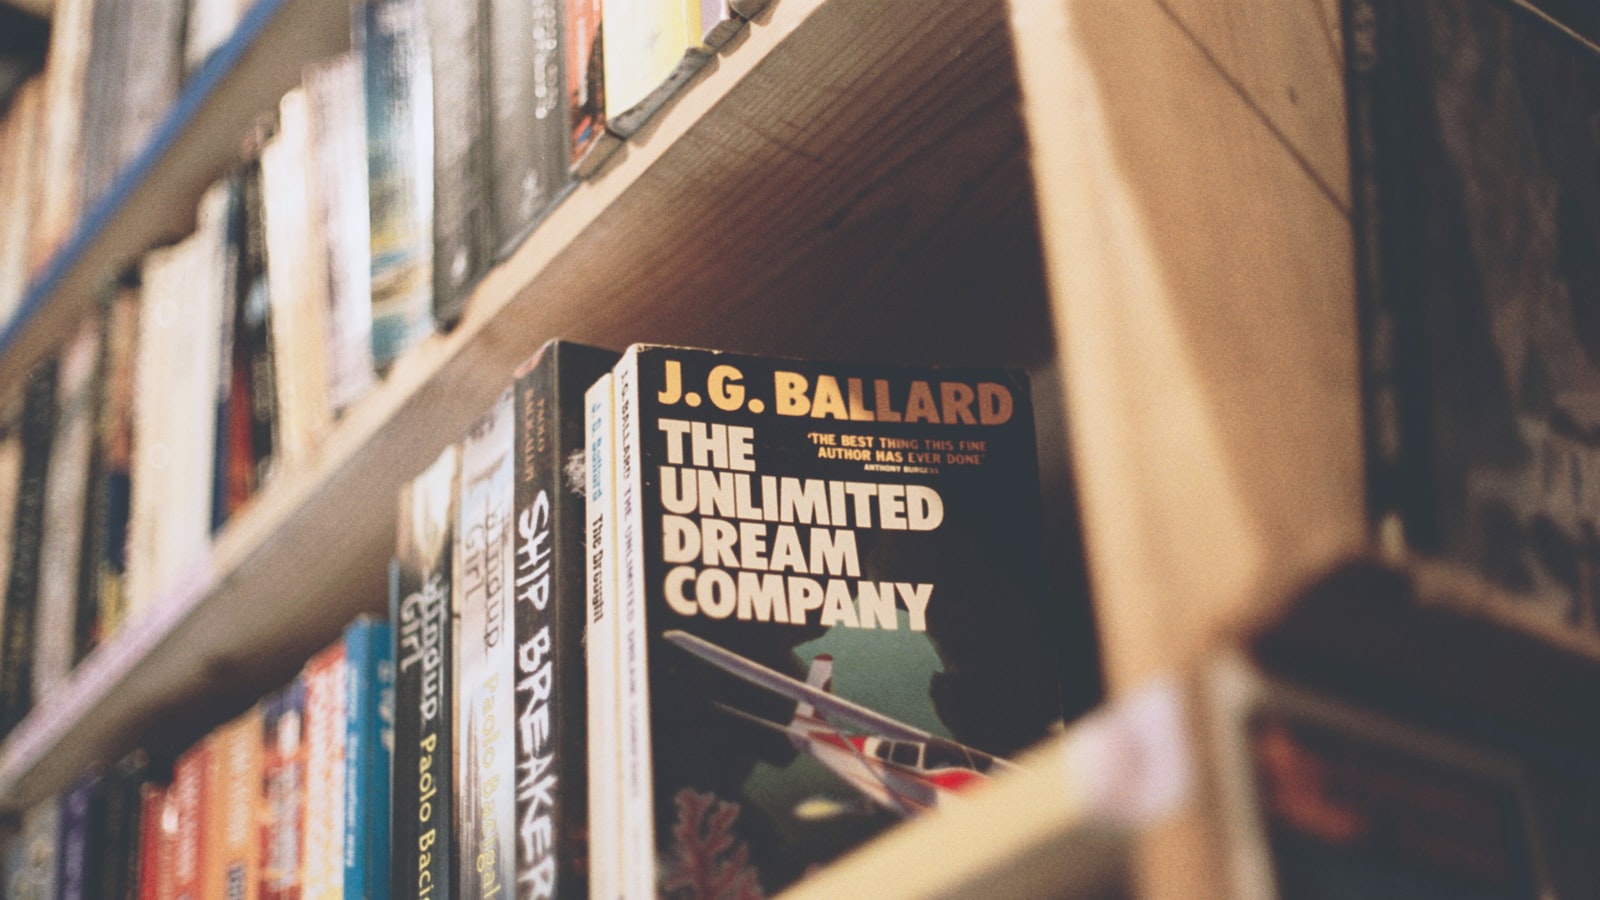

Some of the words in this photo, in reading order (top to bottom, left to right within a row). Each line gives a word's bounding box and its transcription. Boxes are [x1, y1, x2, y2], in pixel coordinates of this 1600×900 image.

[774, 370, 1014, 425] BALLARD
[658, 418, 756, 472] THE
[818, 447, 871, 461] AUTHOR
[876, 450, 903, 463] HAS
[908, 452, 941, 464] EVER
[841, 435, 874, 448] BEST
[879, 437, 918, 450] THING
[924, 439, 953, 451] THIS
[959, 441, 986, 453] FINE
[864, 463, 901, 473] ANTHONY
[592, 513, 603, 548] The
[660, 466, 944, 531] UNLIMITED
[466, 524, 485, 601] Girl
[516, 490, 551, 610] SHIP
[662, 514, 861, 577] DREAM
[592, 550, 604, 623] Drought
[663, 566, 934, 631] COMPANY
[401, 592, 424, 673] Girl
[482, 672, 501, 769] Paolo
[419, 733, 437, 822] Paolo
[516, 625, 558, 900] BREAKER
[419, 828, 436, 900] Baci
